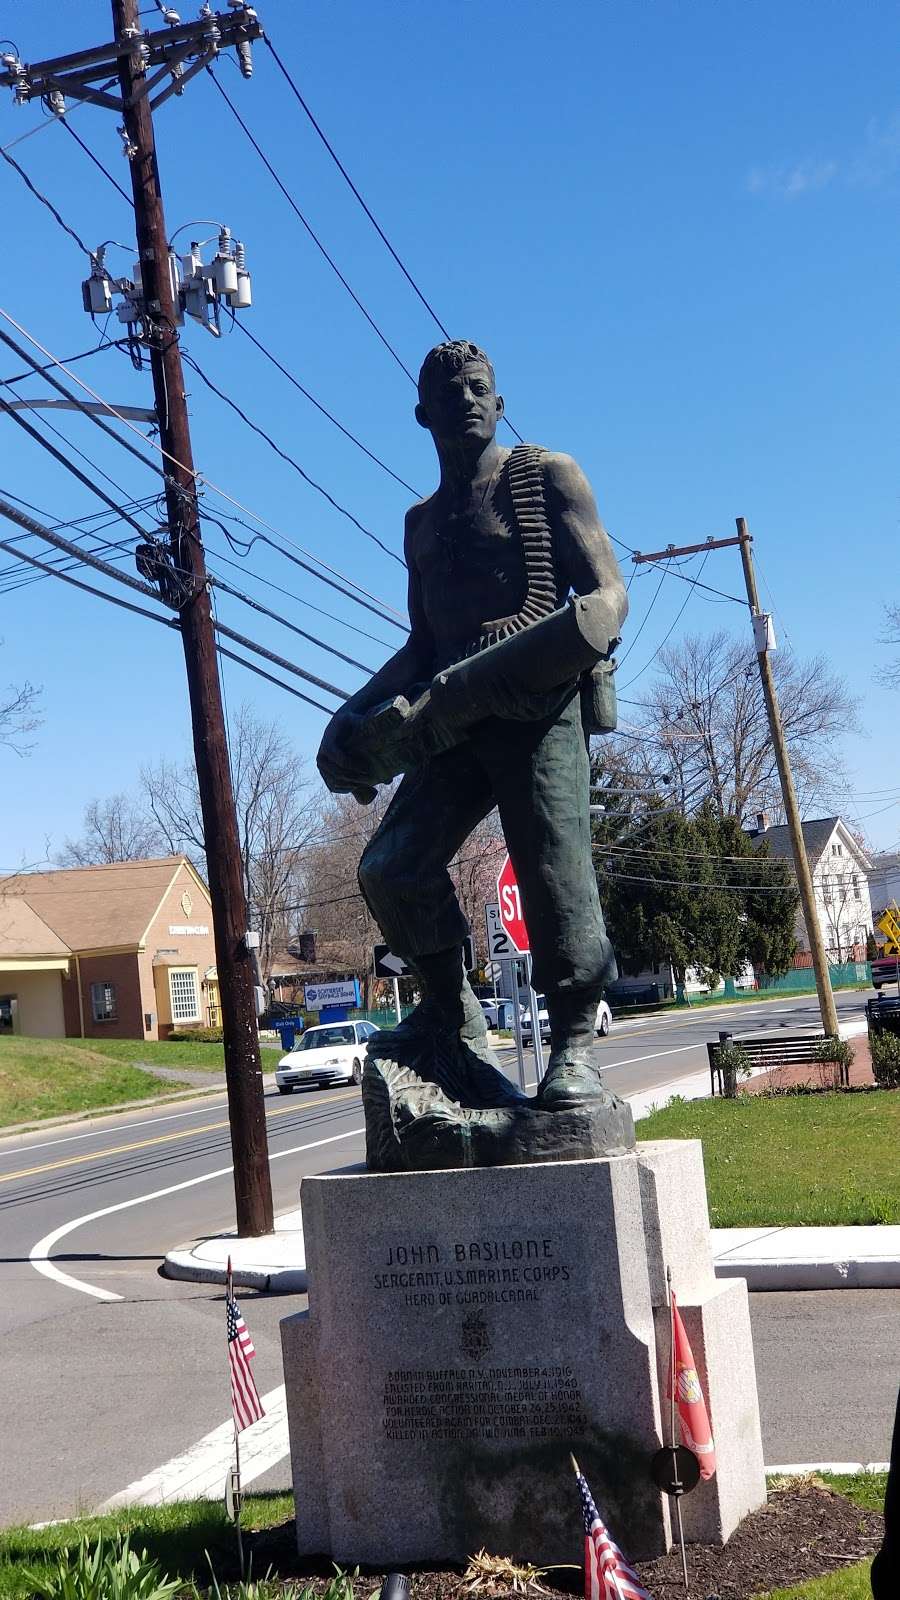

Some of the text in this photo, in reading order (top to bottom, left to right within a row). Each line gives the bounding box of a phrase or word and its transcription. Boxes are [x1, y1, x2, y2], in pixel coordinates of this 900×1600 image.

[502, 884, 522, 922] ST
[493, 933, 517, 954] 2
[386, 1239, 554, 1266] JOHN BASILONE
[466, 1267, 520, 1285] MARINE
[523, 1265, 570, 1282] CORPS
[405, 1288, 541, 1306] HERO OF GUADALCANAL
[489, 1366, 540, 1379] NOVEMBER
[385, 1382, 426, 1394] ENLISTED
[428, 1381, 454, 1393] FROM
[383, 1394, 427, 1405] AWARDED
[504, 1391, 537, 1403] MEDAL
[538, 1390, 549, 1401] OF
[551, 1389, 582, 1401] HONOR
[386, 1406, 402, 1417] FOR
[487, 1403, 527, 1415] OCTOBER
[386, 1429, 416, 1441] KILLED
